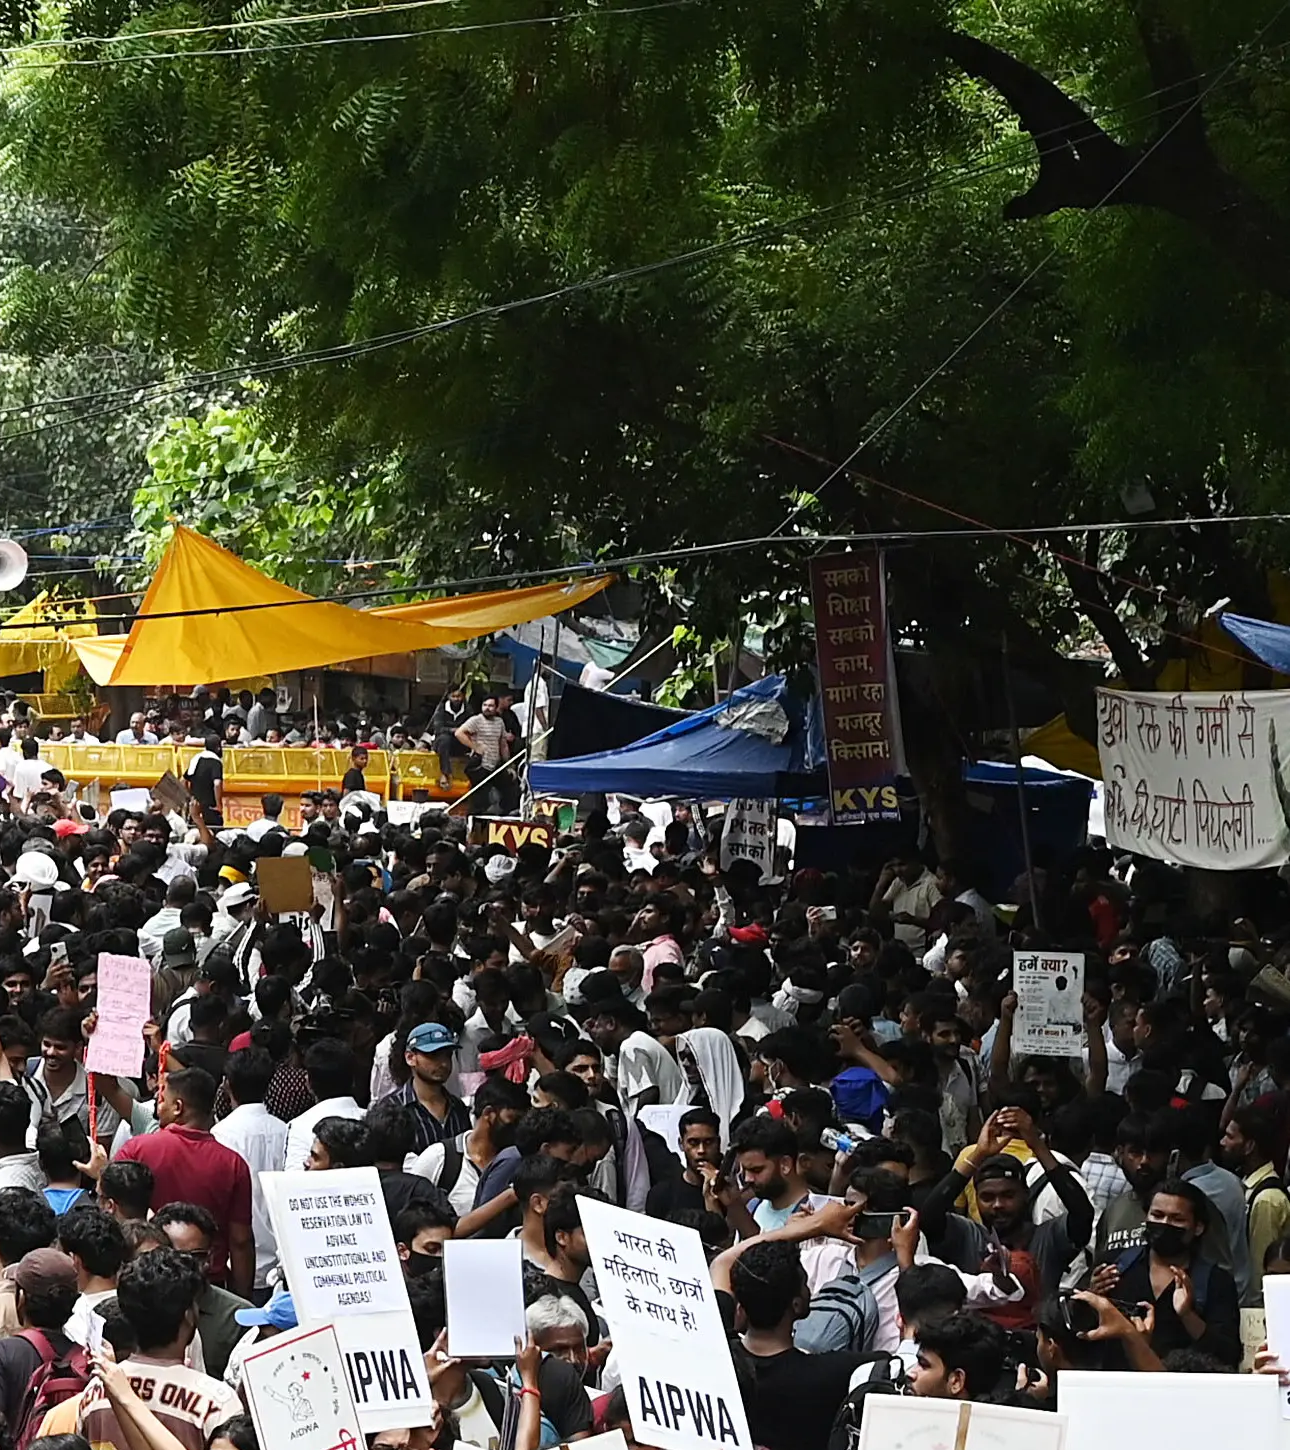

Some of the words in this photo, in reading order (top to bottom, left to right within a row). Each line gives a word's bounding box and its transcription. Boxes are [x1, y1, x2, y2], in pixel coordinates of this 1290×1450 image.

[824, 563, 870, 588] सबको
[826, 593, 871, 616] शिक्षा
[827, 618, 874, 646] सबको
[833, 653, 873, 675] काम,
[825, 683, 858, 704] मांग
[862, 683, 885, 701] रहा
[835, 711, 883, 736] मजदूर
[1165, 694, 1188, 760] की
[1236, 692, 1255, 759] से
[830, 738, 890, 763] किसान!
[833, 786, 898, 812] KYS
[489, 822, 549, 849] KYS
[1018, 955, 1039, 971] हमें
[1041, 959, 1068, 973] क्या?
[289, 1199, 298, 1211] DO
[300, 1197, 313, 1210] NOT
[314, 1197, 328, 1209] USE
[329, 1195, 342, 1208] THE
[343, 1193, 376, 1207] WOMEN'S
[301, 1215, 348, 1229] RESERVATION
[350, 1213, 363, 1226] LAW
[363, 1213, 373, 1225] TO
[325, 1233, 358, 1247] ADVANCE
[613, 1229, 653, 1257] भारत
[655, 1238, 678, 1264] की
[304, 1252, 371, 1269] UNCONSTITUTIONAL
[372, 1250, 386, 1263] AND
[313, 1273, 353, 1288] COMMUNAL
[353, 1270, 387, 1285] POLITICAL
[602, 1255, 666, 1296] महिलाएं,
[668, 1278, 705, 1302] छात्रों
[337, 1292, 372, 1306] AGENDAS!
[624, 1288, 642, 1314] के
[644, 1300, 678, 1325] साथ
[345, 1349, 421, 1403] IPWA
[160, 1383, 221, 1424] ONLY
[638, 1375, 740, 1446] AIPWA
[290, 1422, 319, 1440] AIDWA
